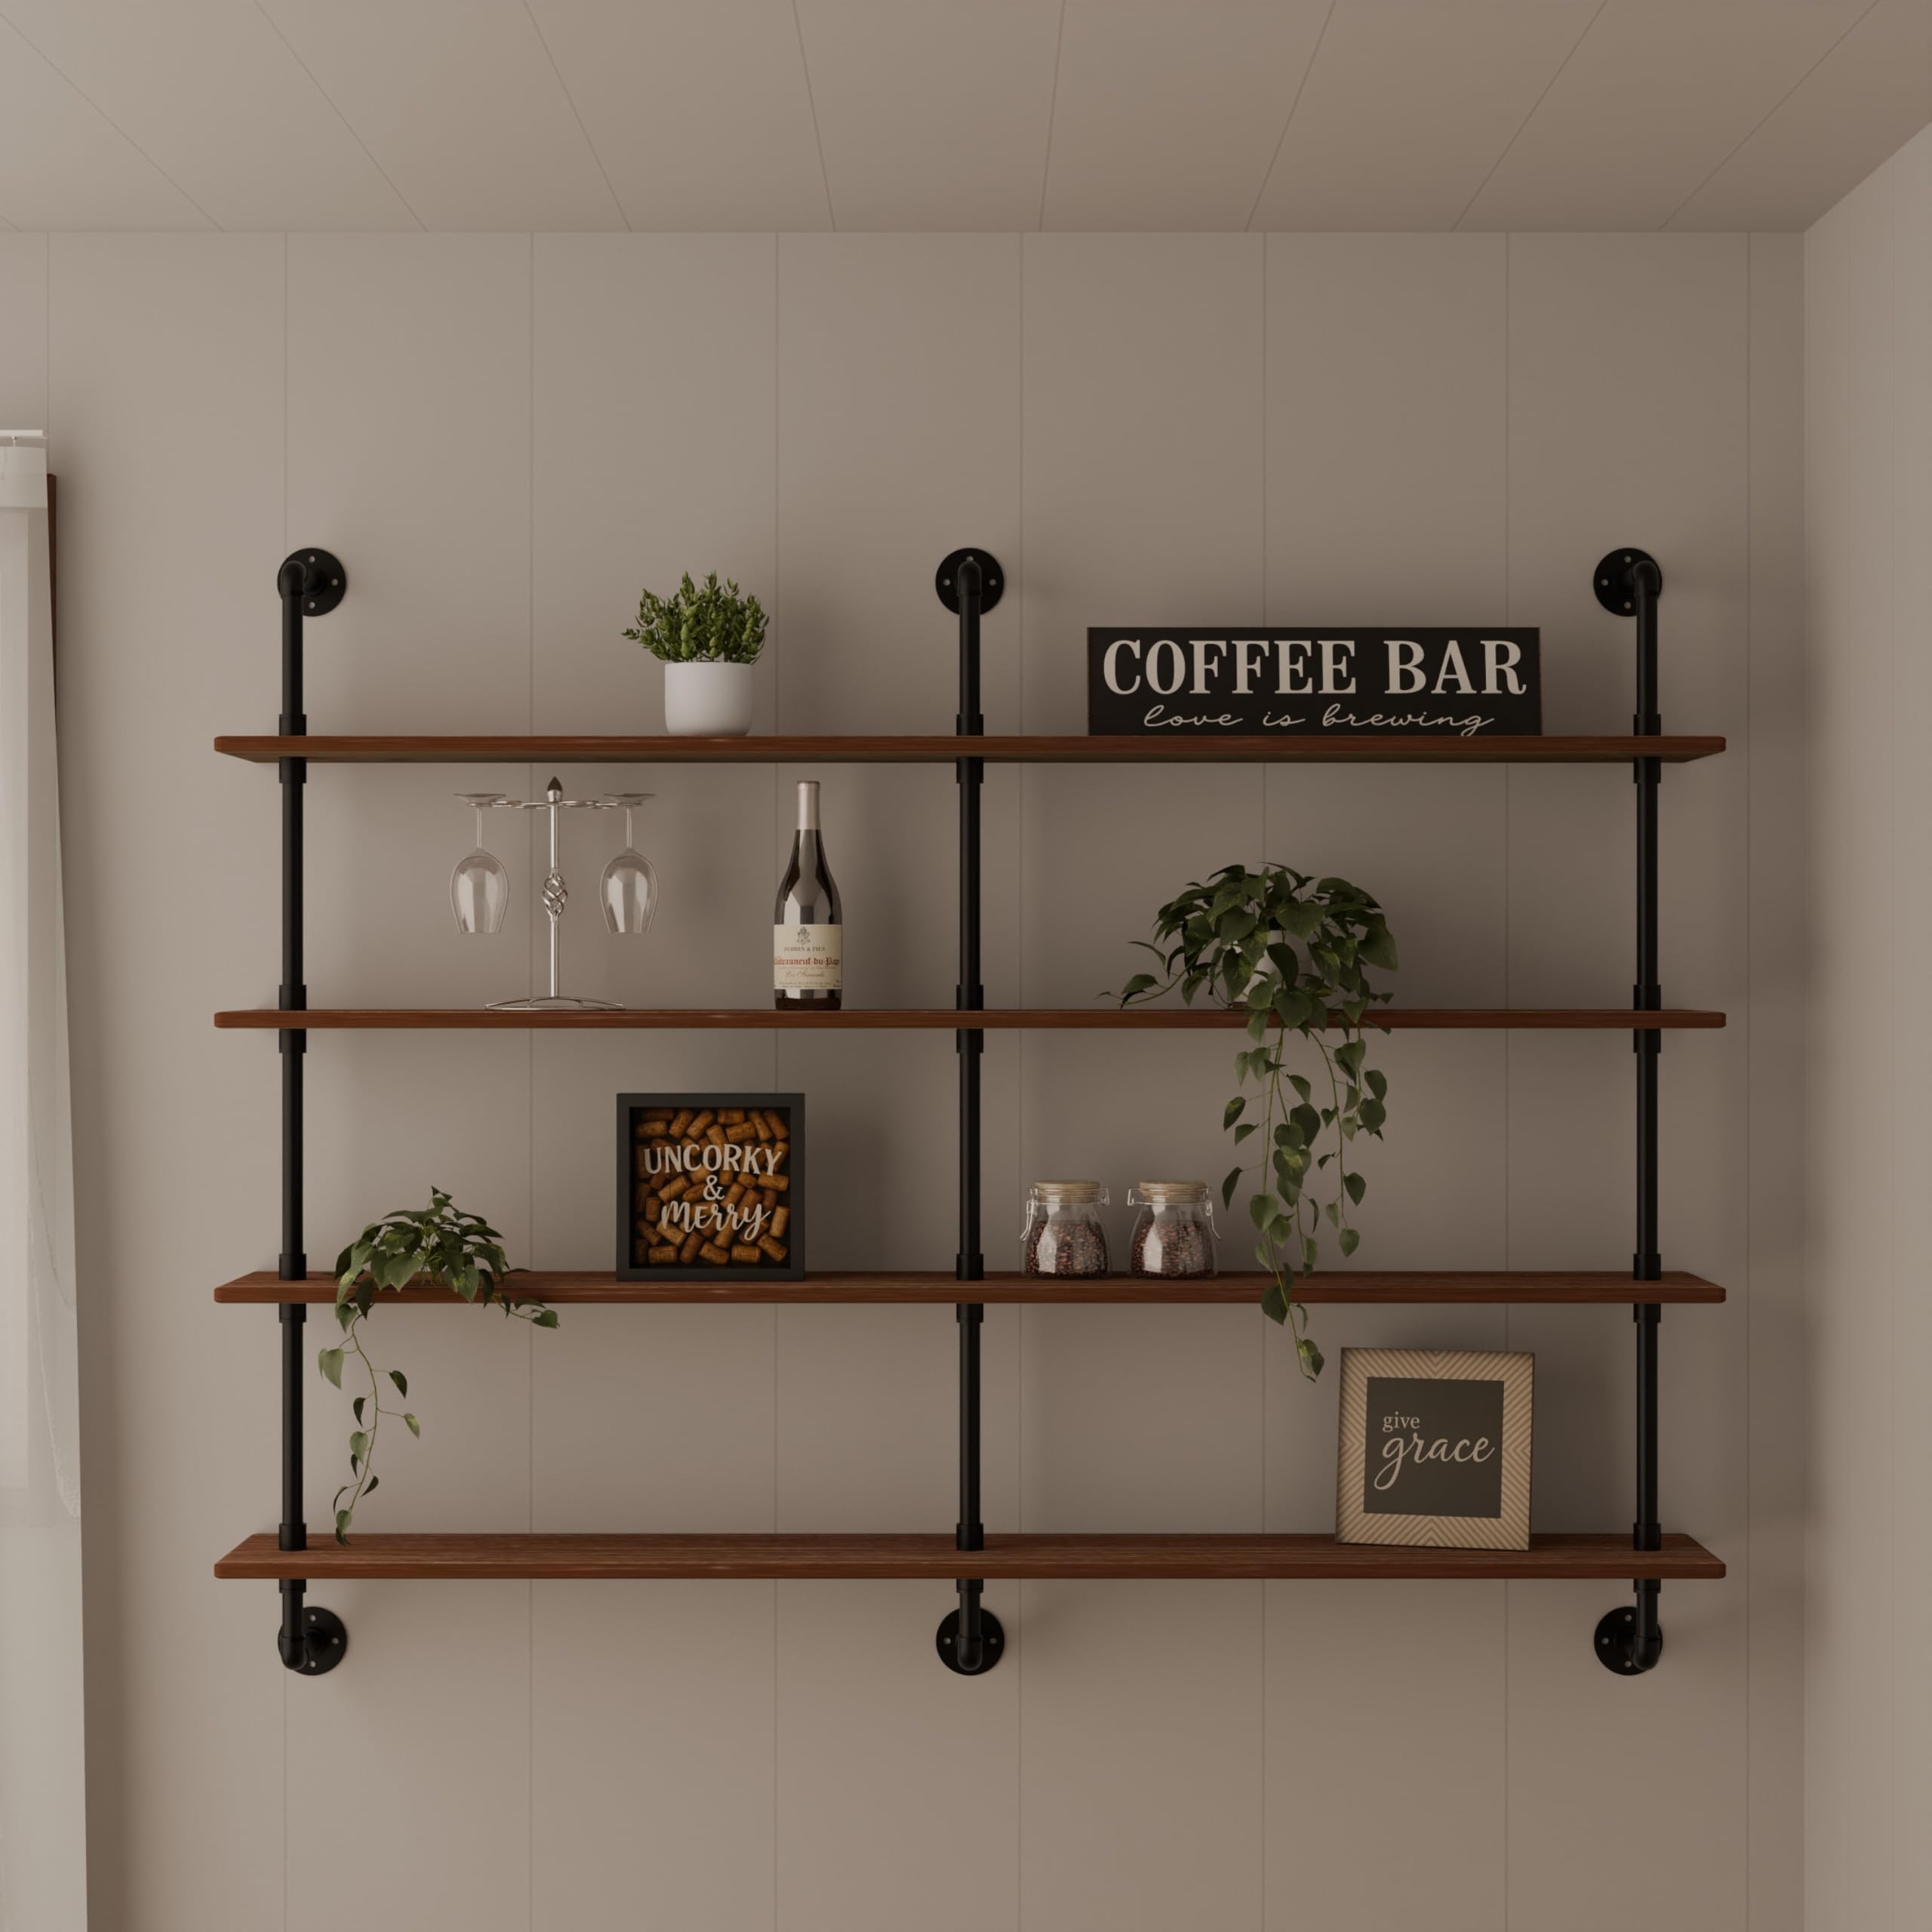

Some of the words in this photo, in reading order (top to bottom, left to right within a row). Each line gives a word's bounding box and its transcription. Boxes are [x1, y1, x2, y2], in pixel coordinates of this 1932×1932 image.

[1103, 639, 1356, 695] COFFEE
[1383, 640, 1527, 695] BAR
[1143, 704, 1244, 727] love
[1263, 711, 1306, 727] is
[1321, 703, 1494, 736] brewing
[644, 1143, 783, 1176] UNCORKY
[703, 1175, 724, 1200] &
[1383, 1411, 1420, 1432] give
[1374, 1432, 1495, 1491] grace
